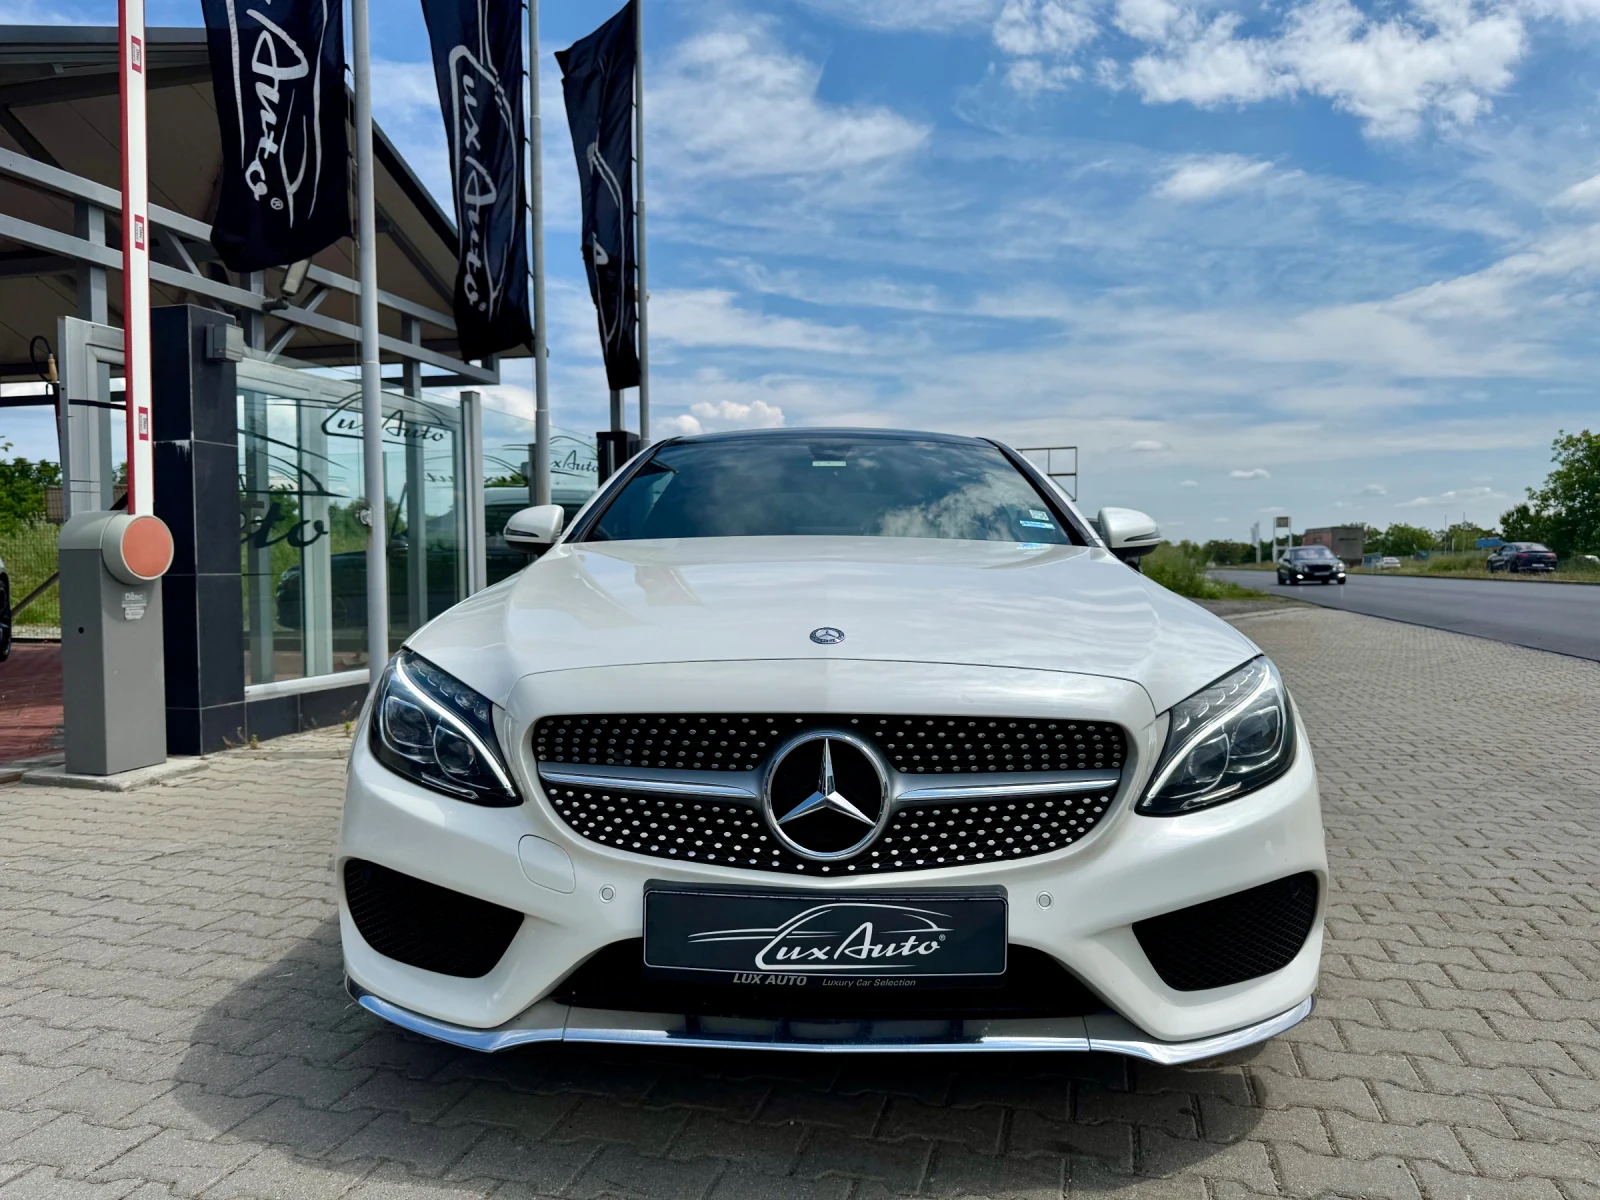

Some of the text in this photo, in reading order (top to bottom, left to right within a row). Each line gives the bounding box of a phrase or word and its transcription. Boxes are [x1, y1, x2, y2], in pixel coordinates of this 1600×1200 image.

[733, 973, 807, 986] LUX AUTO
[822, 978, 916, 988] Luxury Car Selection
